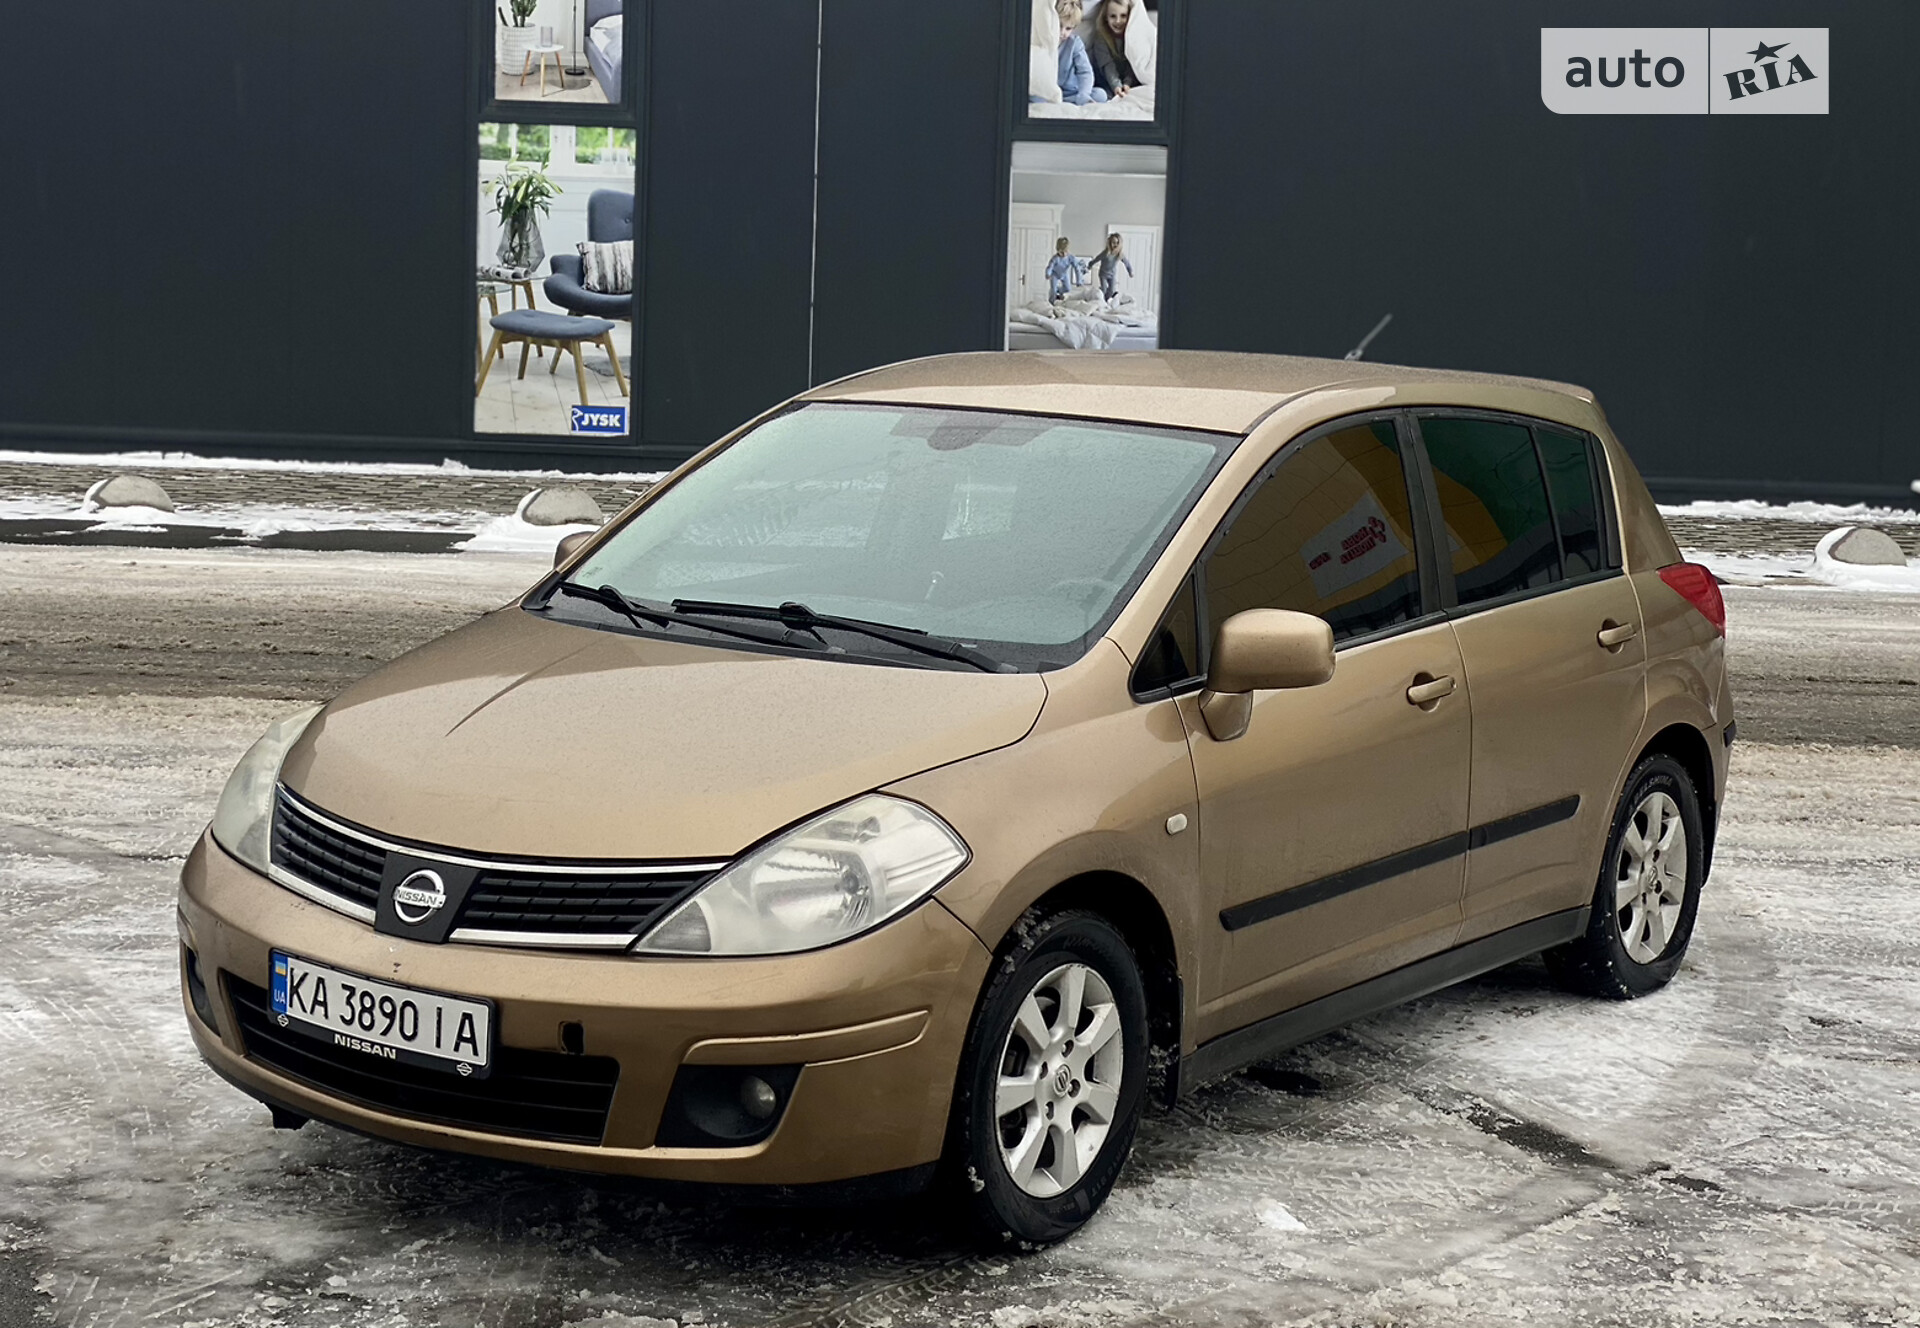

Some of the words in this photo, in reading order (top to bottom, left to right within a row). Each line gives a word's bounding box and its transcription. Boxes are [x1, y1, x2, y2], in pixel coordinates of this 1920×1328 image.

[581, 413, 621, 427] JYSK
[396, 888, 438, 906] NISSAN
[273, 988, 286, 1004] UA
[289, 967, 328, 1019] KA
[339, 983, 419, 1042] 3890
[435, 1006, 479, 1057] IA
[334, 1033, 396, 1060] NISSAN
